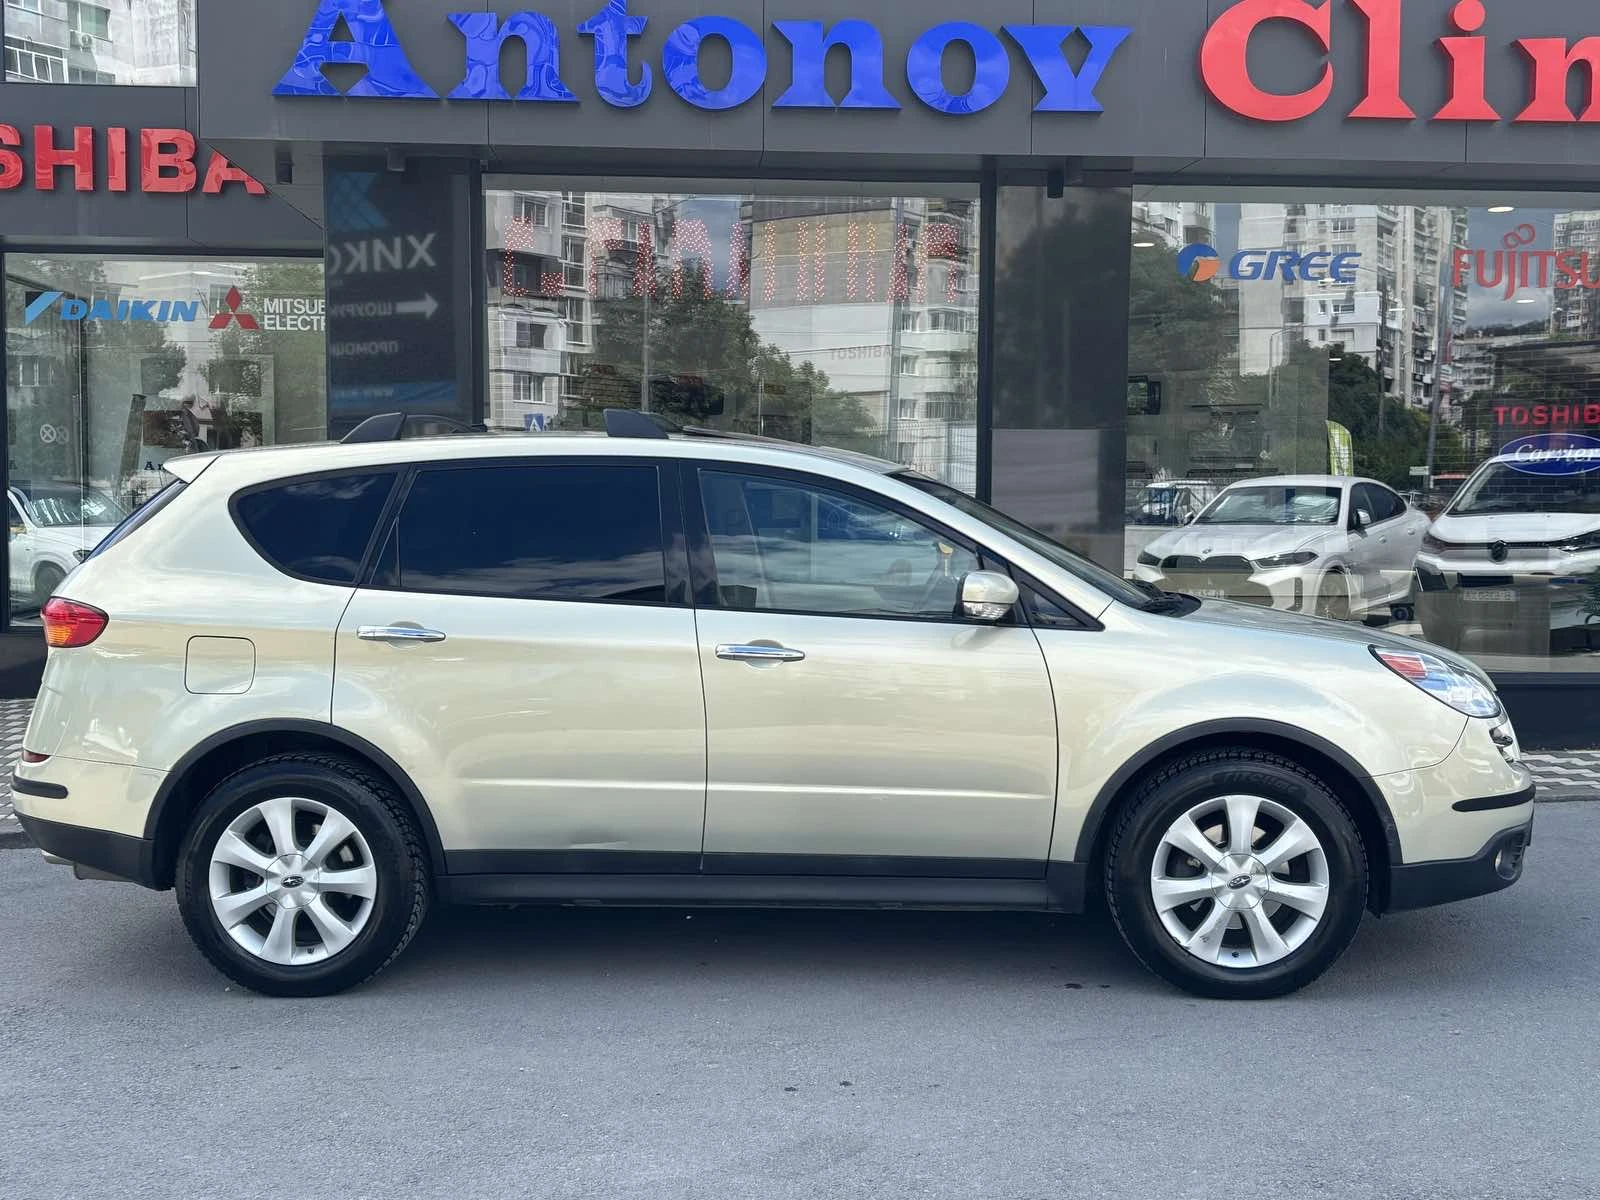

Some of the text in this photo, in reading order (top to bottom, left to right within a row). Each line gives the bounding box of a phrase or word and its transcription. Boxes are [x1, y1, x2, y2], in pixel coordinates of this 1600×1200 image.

[272, 0, 1133, 114] Antonov
[1230, 250, 1362, 283] GREE
[60, 299, 200, 321] DAIKIN
[1515, 444, 1593, 463] Carrier
